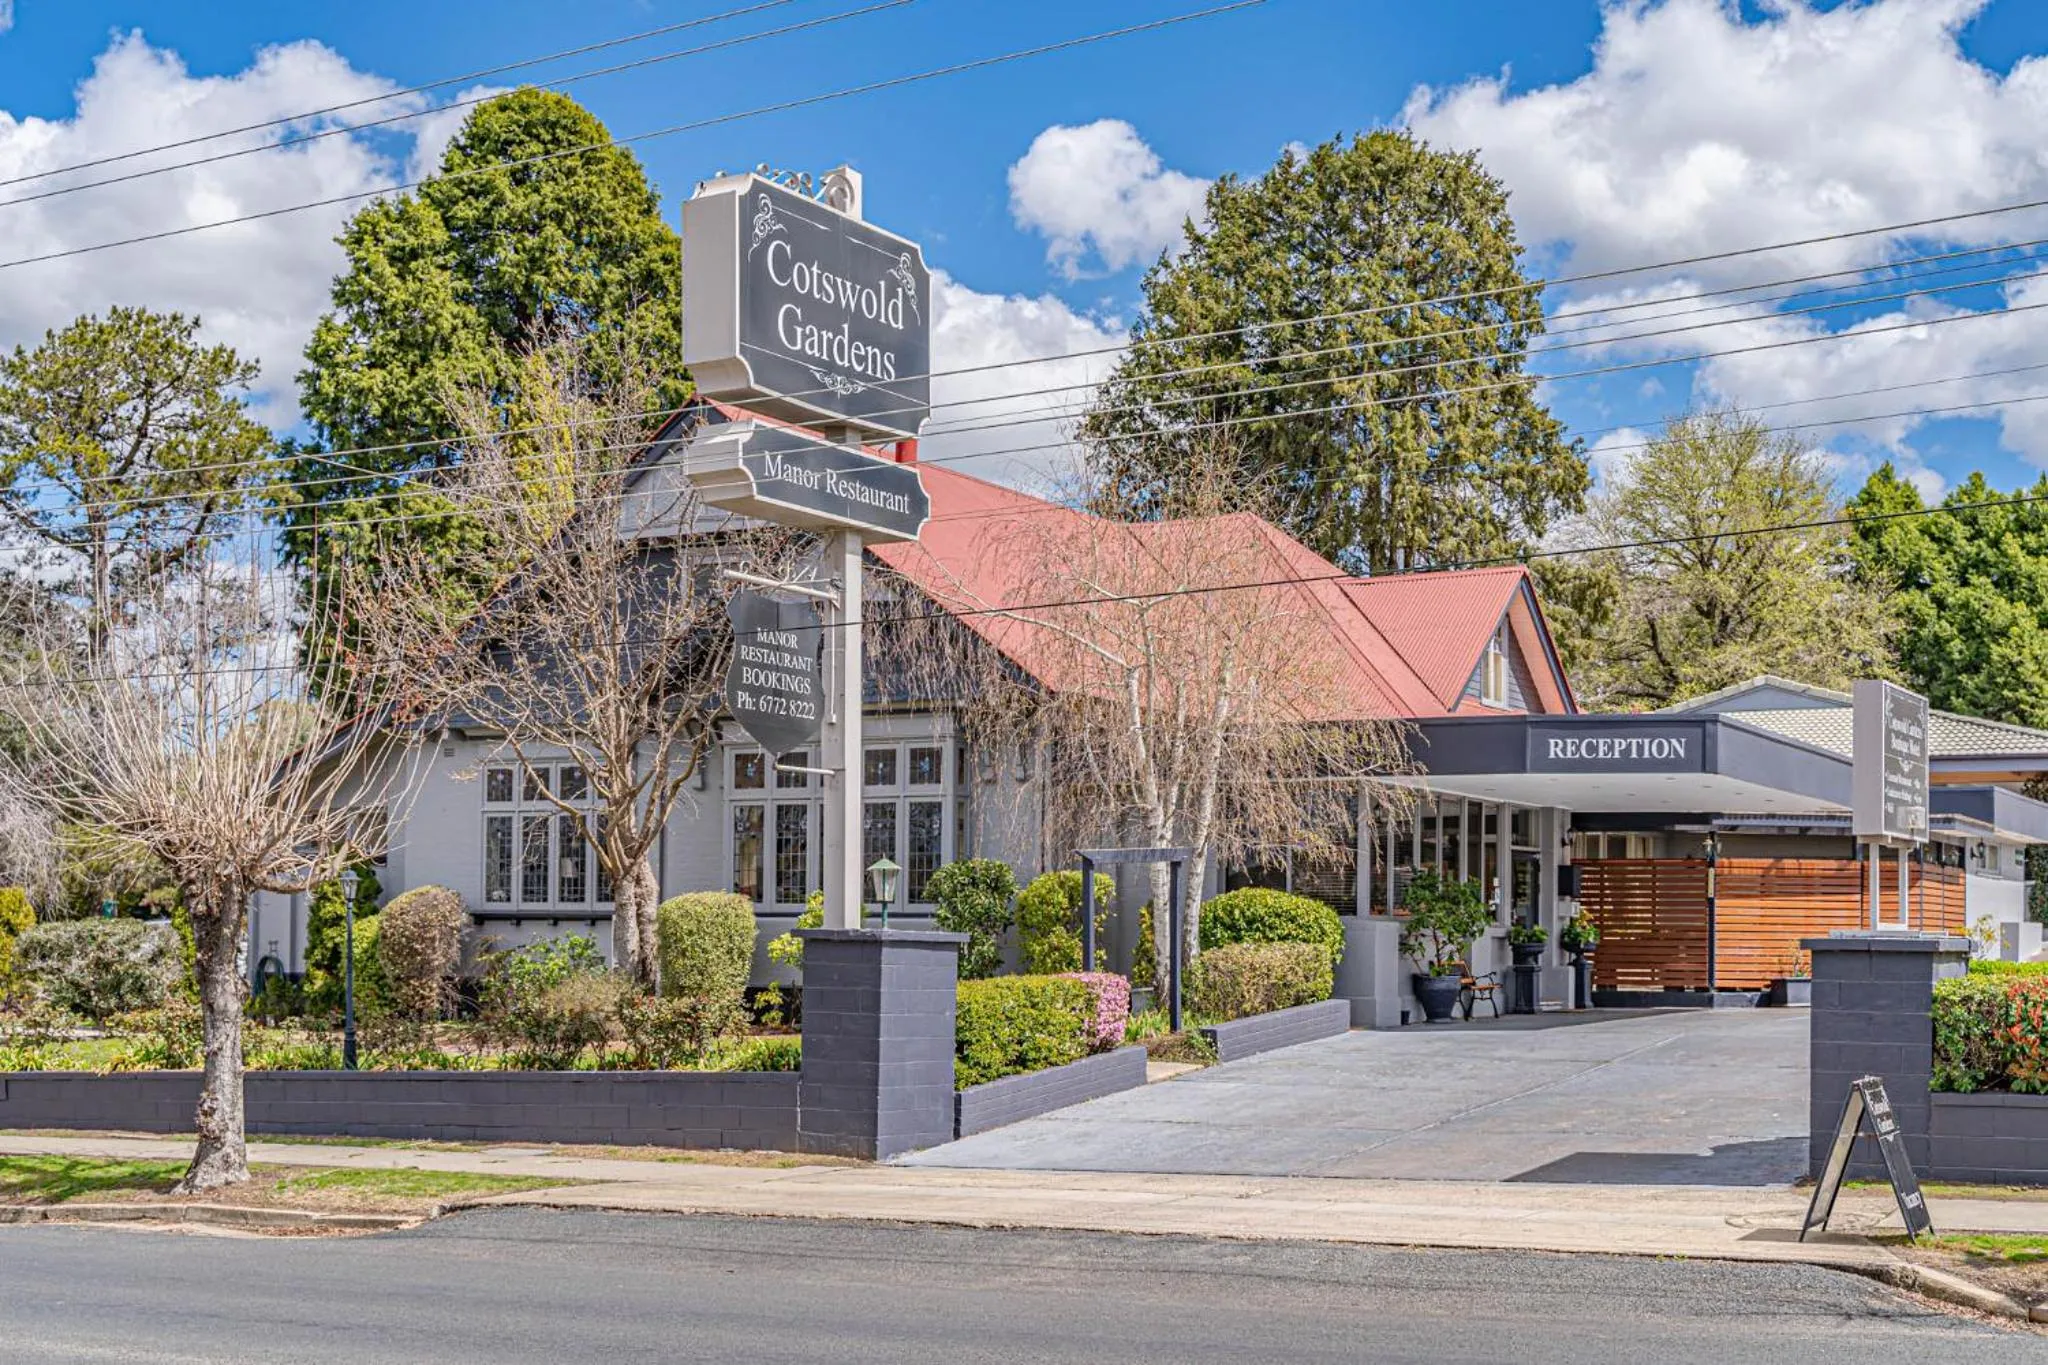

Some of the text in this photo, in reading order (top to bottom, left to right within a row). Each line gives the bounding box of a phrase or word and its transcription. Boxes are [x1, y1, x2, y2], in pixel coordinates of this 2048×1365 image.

[767, 240, 904, 329] Cotswold
[778, 304, 896, 381] Gardens
[764, 451, 910, 514] Manor Restaurant
[757, 627, 799, 649] MANOR
[740, 644, 813, 673] RESTAURANT
[742, 666, 812, 695] BOOKINGS
[737, 690, 815, 720] Ph: 6772 8222
[1548, 738, 1687, 759] RECEPTION
